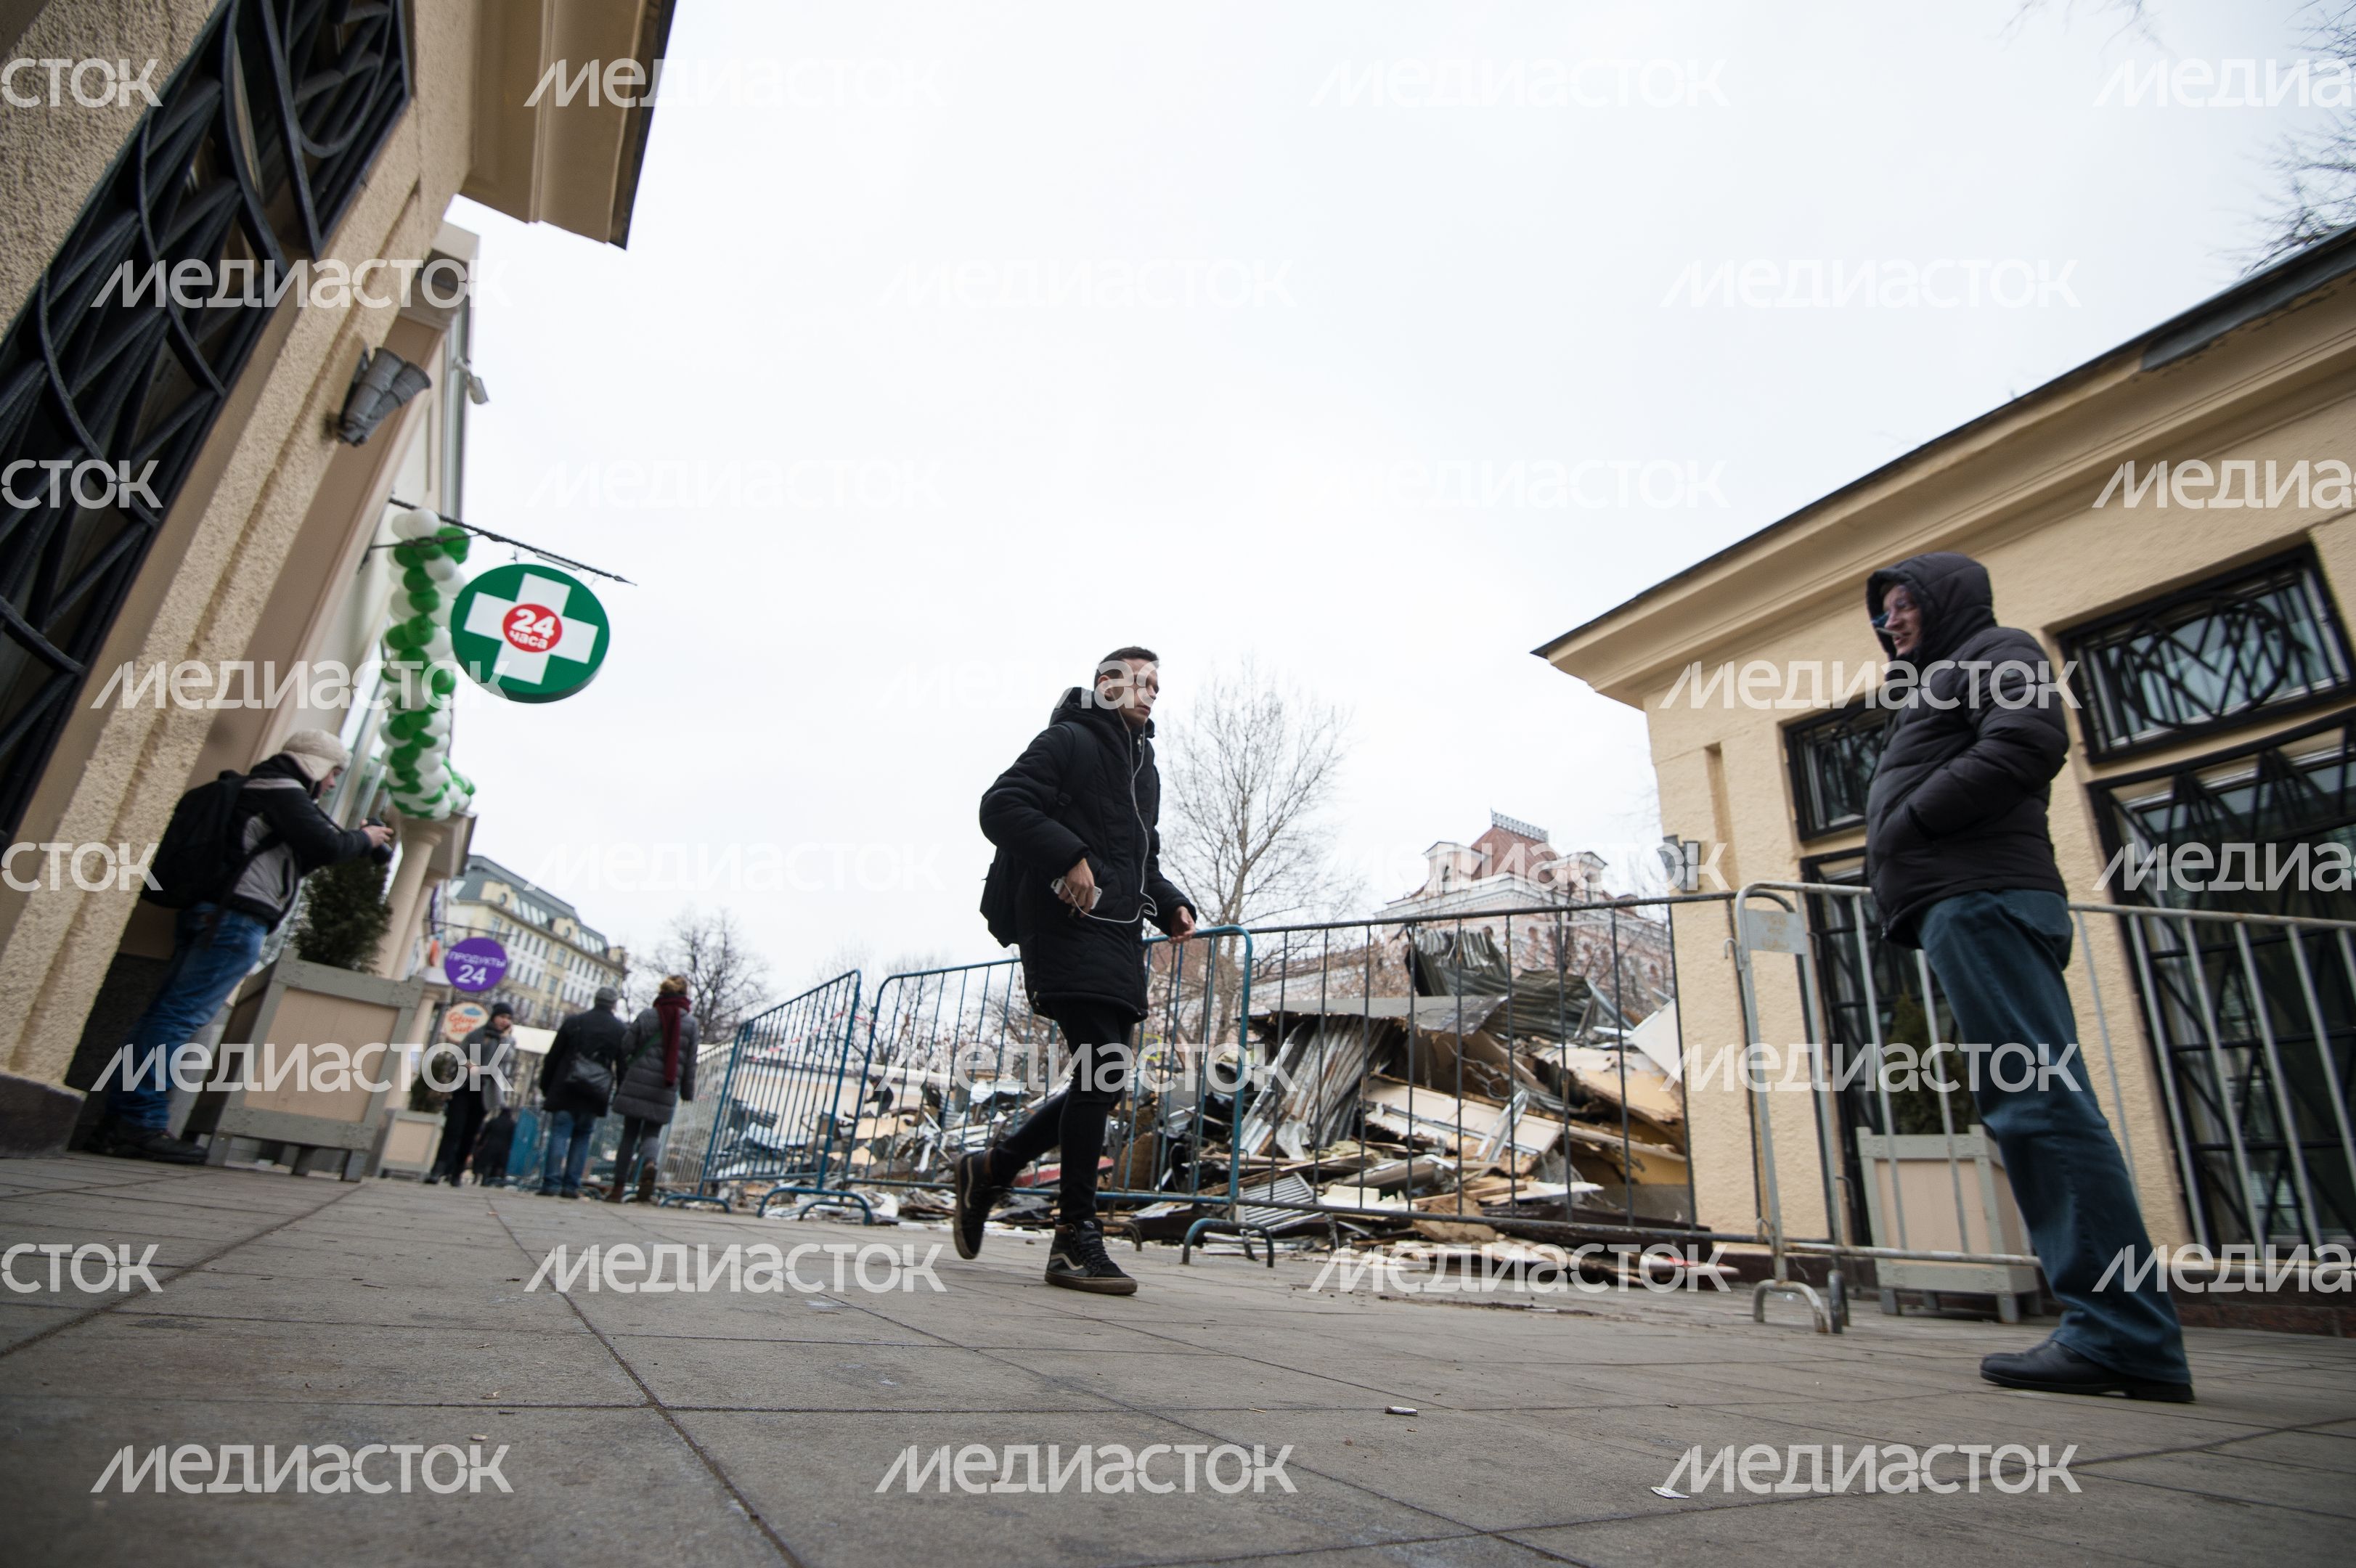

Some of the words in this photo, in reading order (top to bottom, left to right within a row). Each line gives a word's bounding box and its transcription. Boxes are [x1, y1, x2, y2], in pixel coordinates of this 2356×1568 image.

[511, 608, 555, 638] 24
[509, 629, 548, 650] часа
[456, 964, 487, 986] 24
